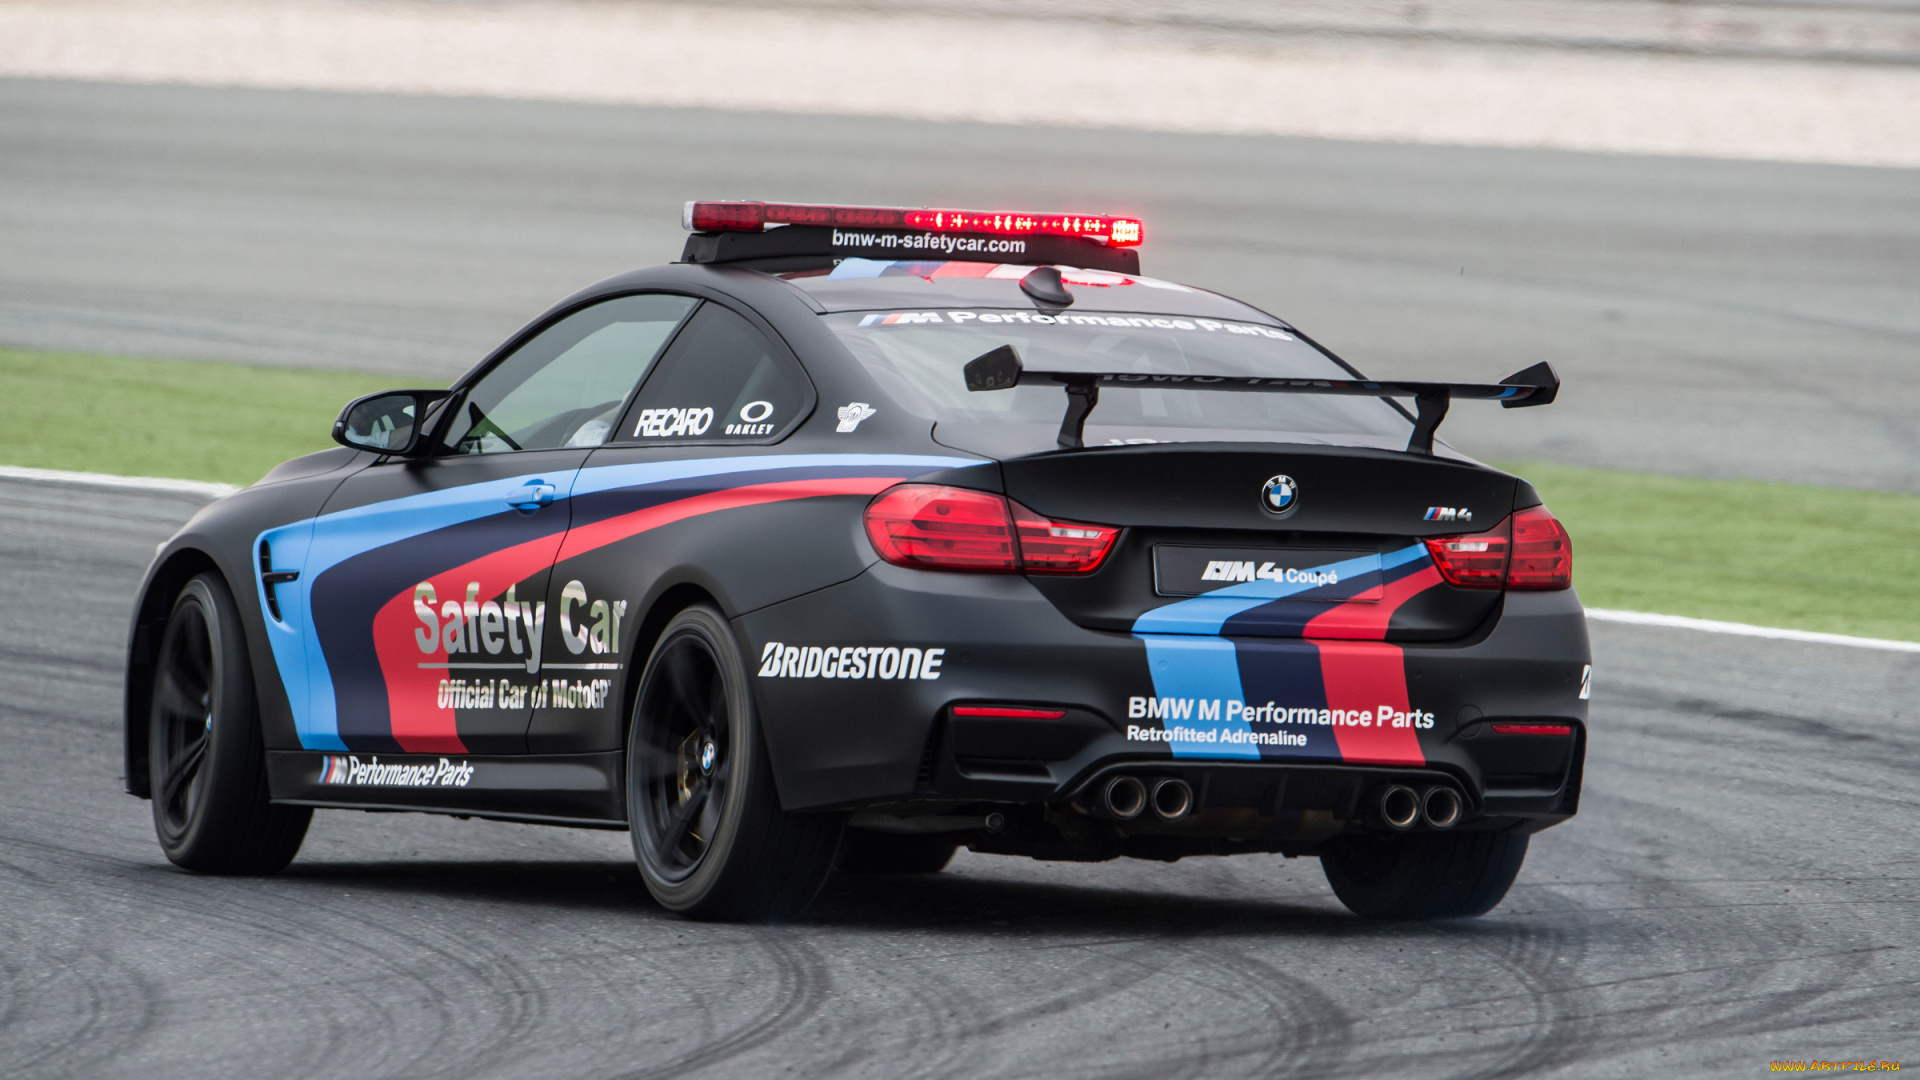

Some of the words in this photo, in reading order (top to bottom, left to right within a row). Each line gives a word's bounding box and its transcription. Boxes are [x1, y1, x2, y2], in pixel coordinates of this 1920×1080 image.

[832, 229, 1026, 253] bmw-m-safetycar.com
[947, 311, 1197, 331] Performance
[1195, 319, 1293, 342] Parts
[633, 407, 714, 437] RECARO
[724, 424, 774, 435] OAKLEY
[1266, 475, 1297, 490] BMW
[1436, 507, 1472, 521] M4
[1223, 560, 1283, 582] M4
[1286, 568, 1338, 587] Coupé
[414, 581, 545, 674] Safety
[560, 580, 628, 655] Car
[757, 642, 946, 680] BRIDGESTONE
[437, 679, 495, 709] Official
[499, 679, 527, 709] Car
[531, 679, 548, 709] of
[1128, 696, 1195, 720] BMW
[1198, 699, 1221, 721] M
[1226, 700, 1373, 727] Performance
[1376, 705, 1435, 729] Parts
[1127, 725, 1217, 744] Retrofitted
[1220, 727, 1307, 746] Adrenaline
[347, 756, 435, 786] Performance
[432, 757, 474, 787] Parts
